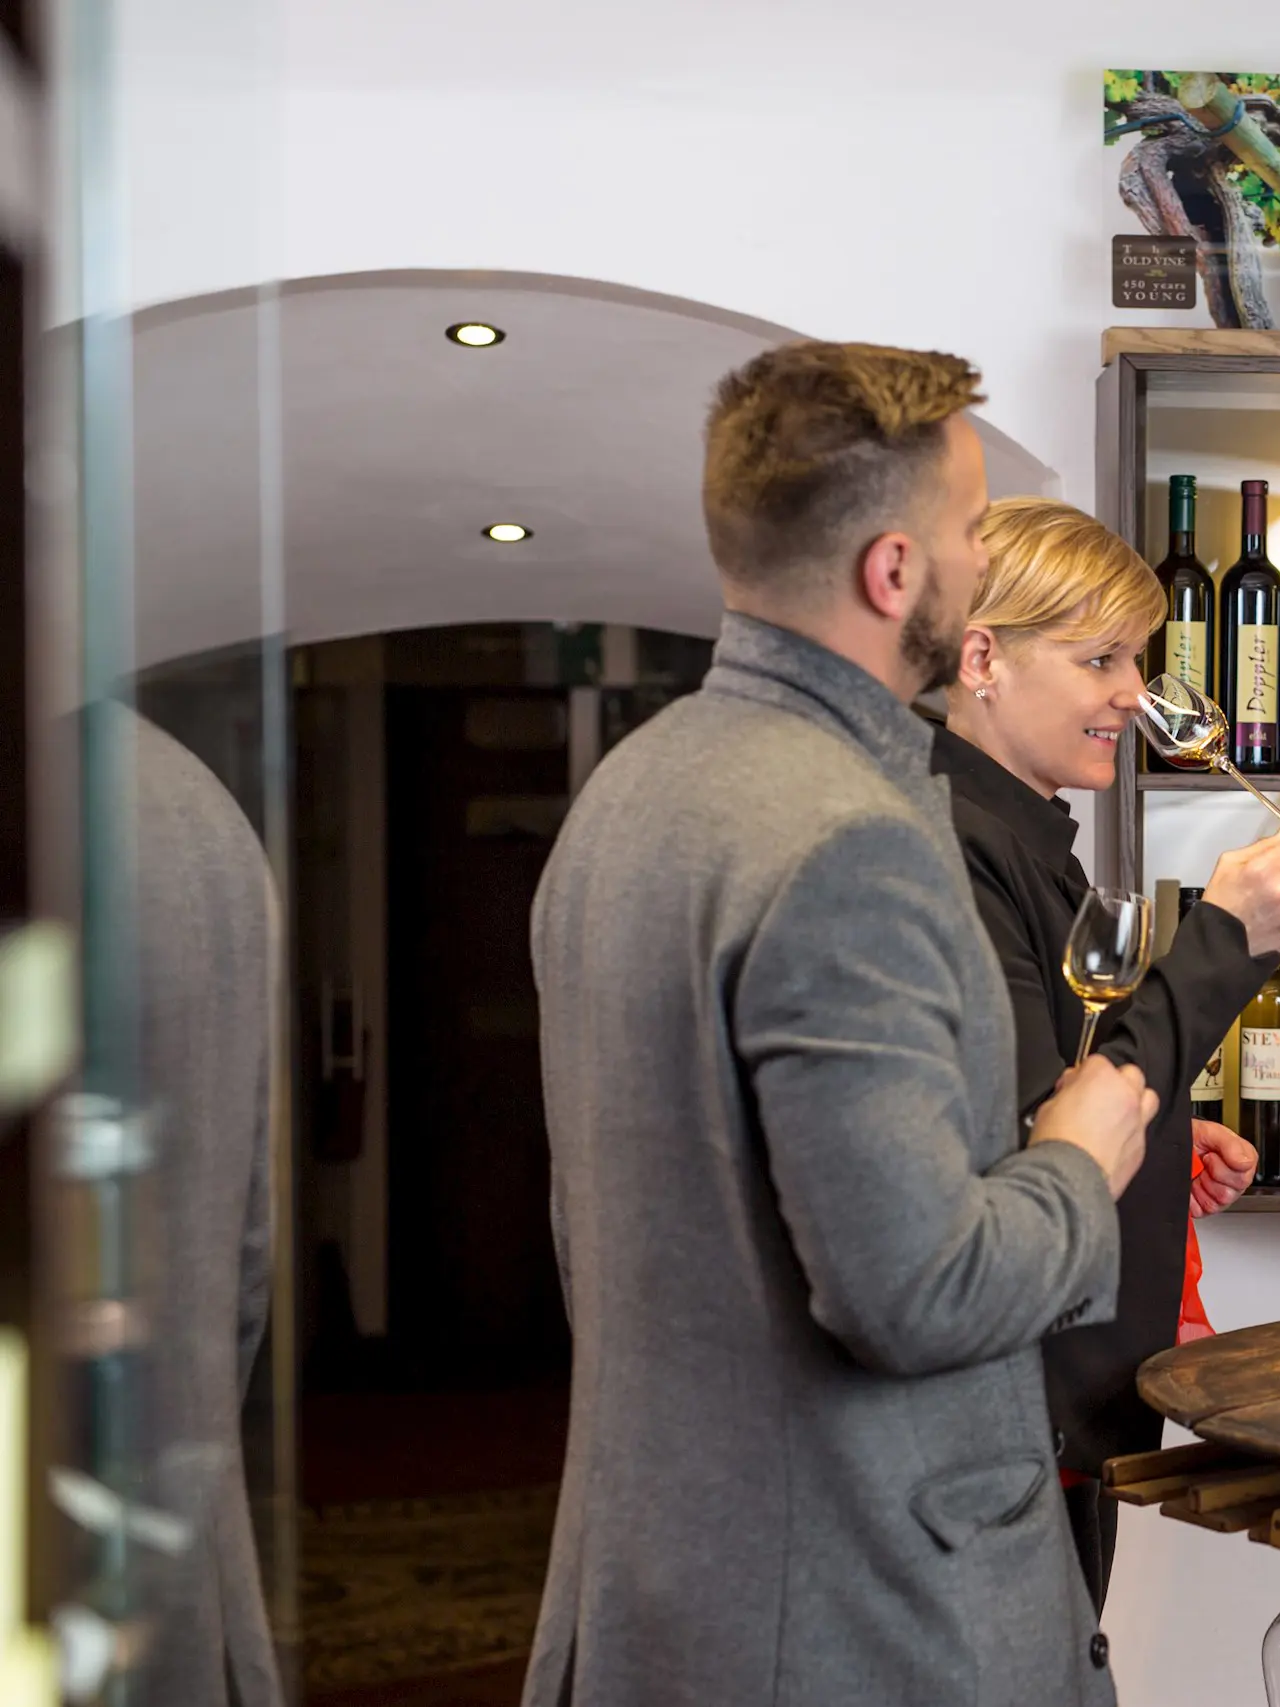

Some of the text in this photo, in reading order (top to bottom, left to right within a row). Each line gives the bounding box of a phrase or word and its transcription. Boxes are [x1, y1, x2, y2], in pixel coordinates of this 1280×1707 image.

[1122, 256, 1187, 267] OLD VINE
[1122, 280, 1187, 291] 450 years
[1123, 291, 1187, 301] YOUNG
[1246, 634, 1276, 715] Doppler
